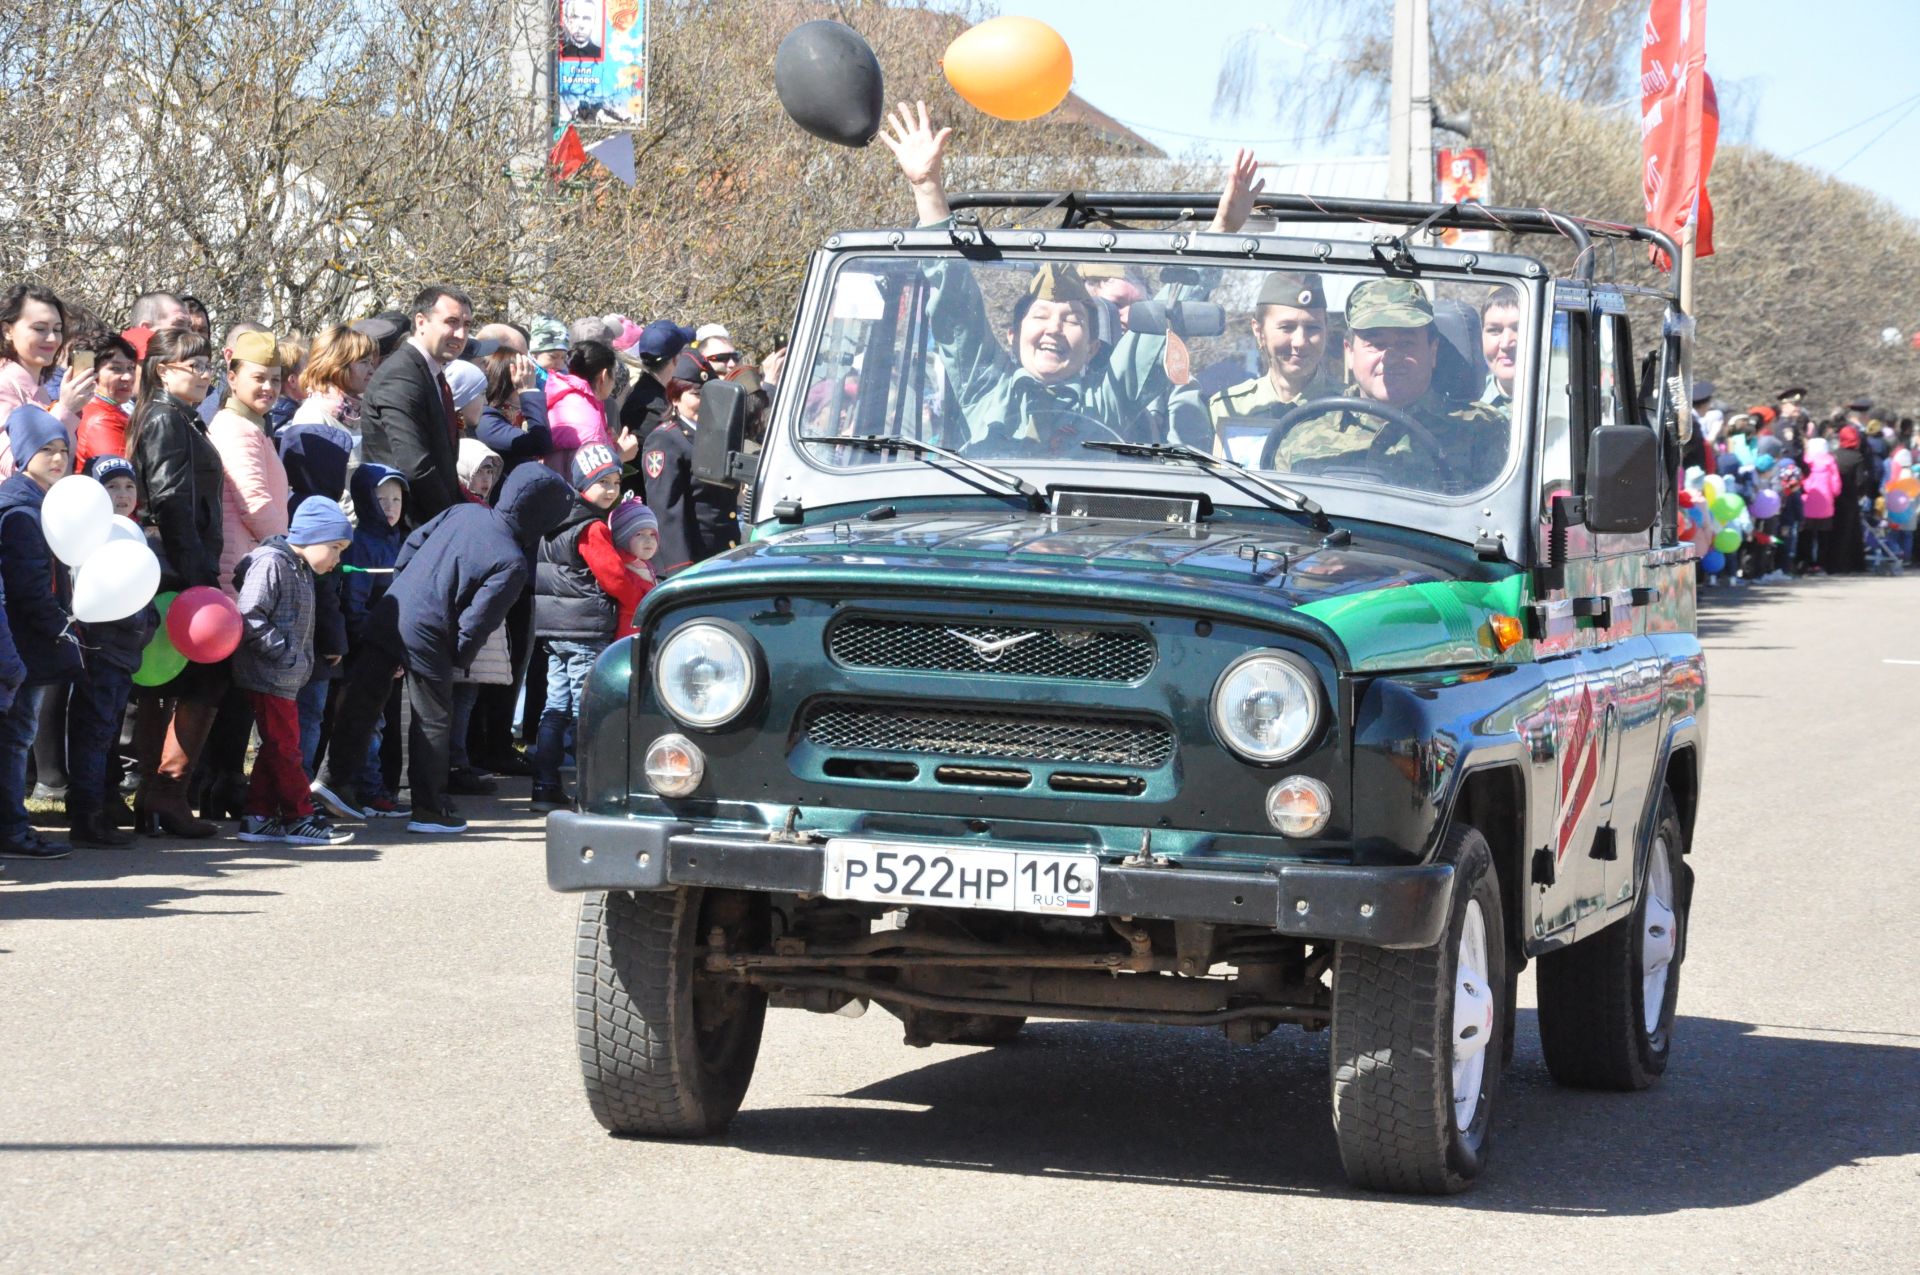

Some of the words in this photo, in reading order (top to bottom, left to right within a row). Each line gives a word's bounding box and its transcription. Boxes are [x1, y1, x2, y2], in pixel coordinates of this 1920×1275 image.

[578, 450, 613, 476] BRO
[1021, 860, 1083, 894] 116
[1033, 894, 1065, 907] RUS
